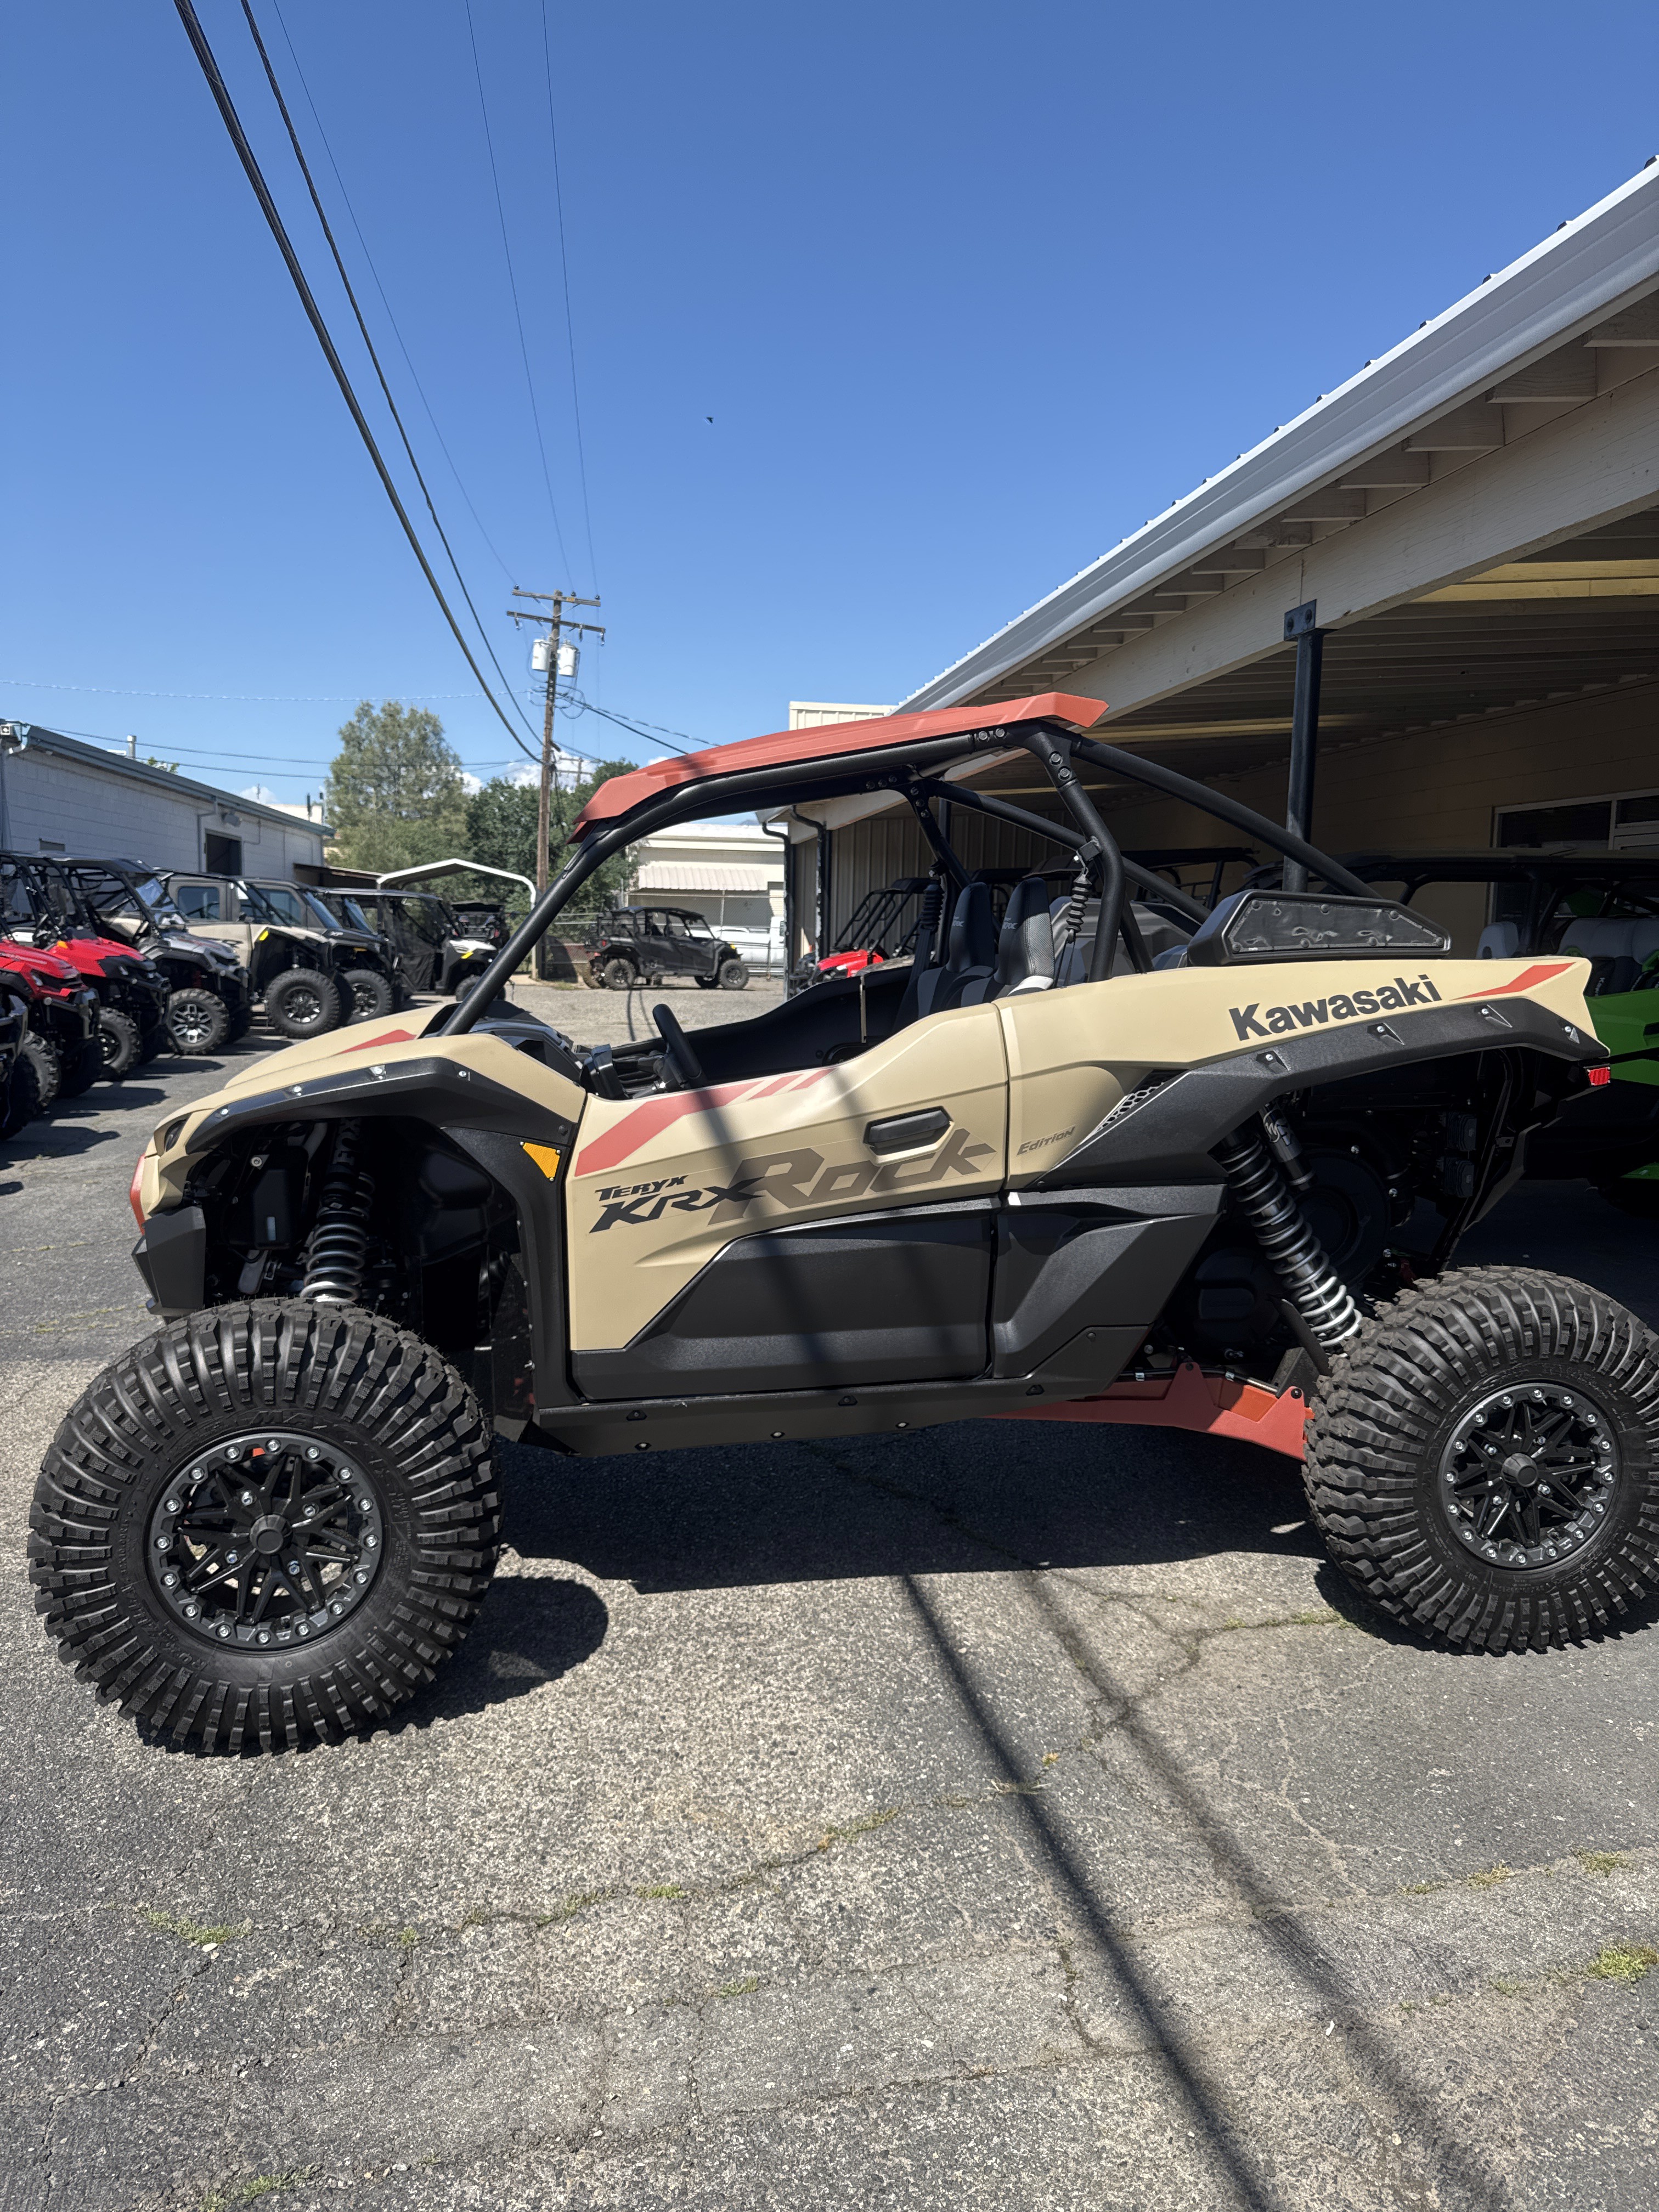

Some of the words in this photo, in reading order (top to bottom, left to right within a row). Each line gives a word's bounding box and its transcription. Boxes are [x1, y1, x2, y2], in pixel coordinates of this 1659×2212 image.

[1228, 974, 1442, 1041] Kawasaki
[332, 1117, 361, 1165] FOX
[589, 1176, 767, 1233] KRX
[595, 1175, 689, 1201] TERYX
